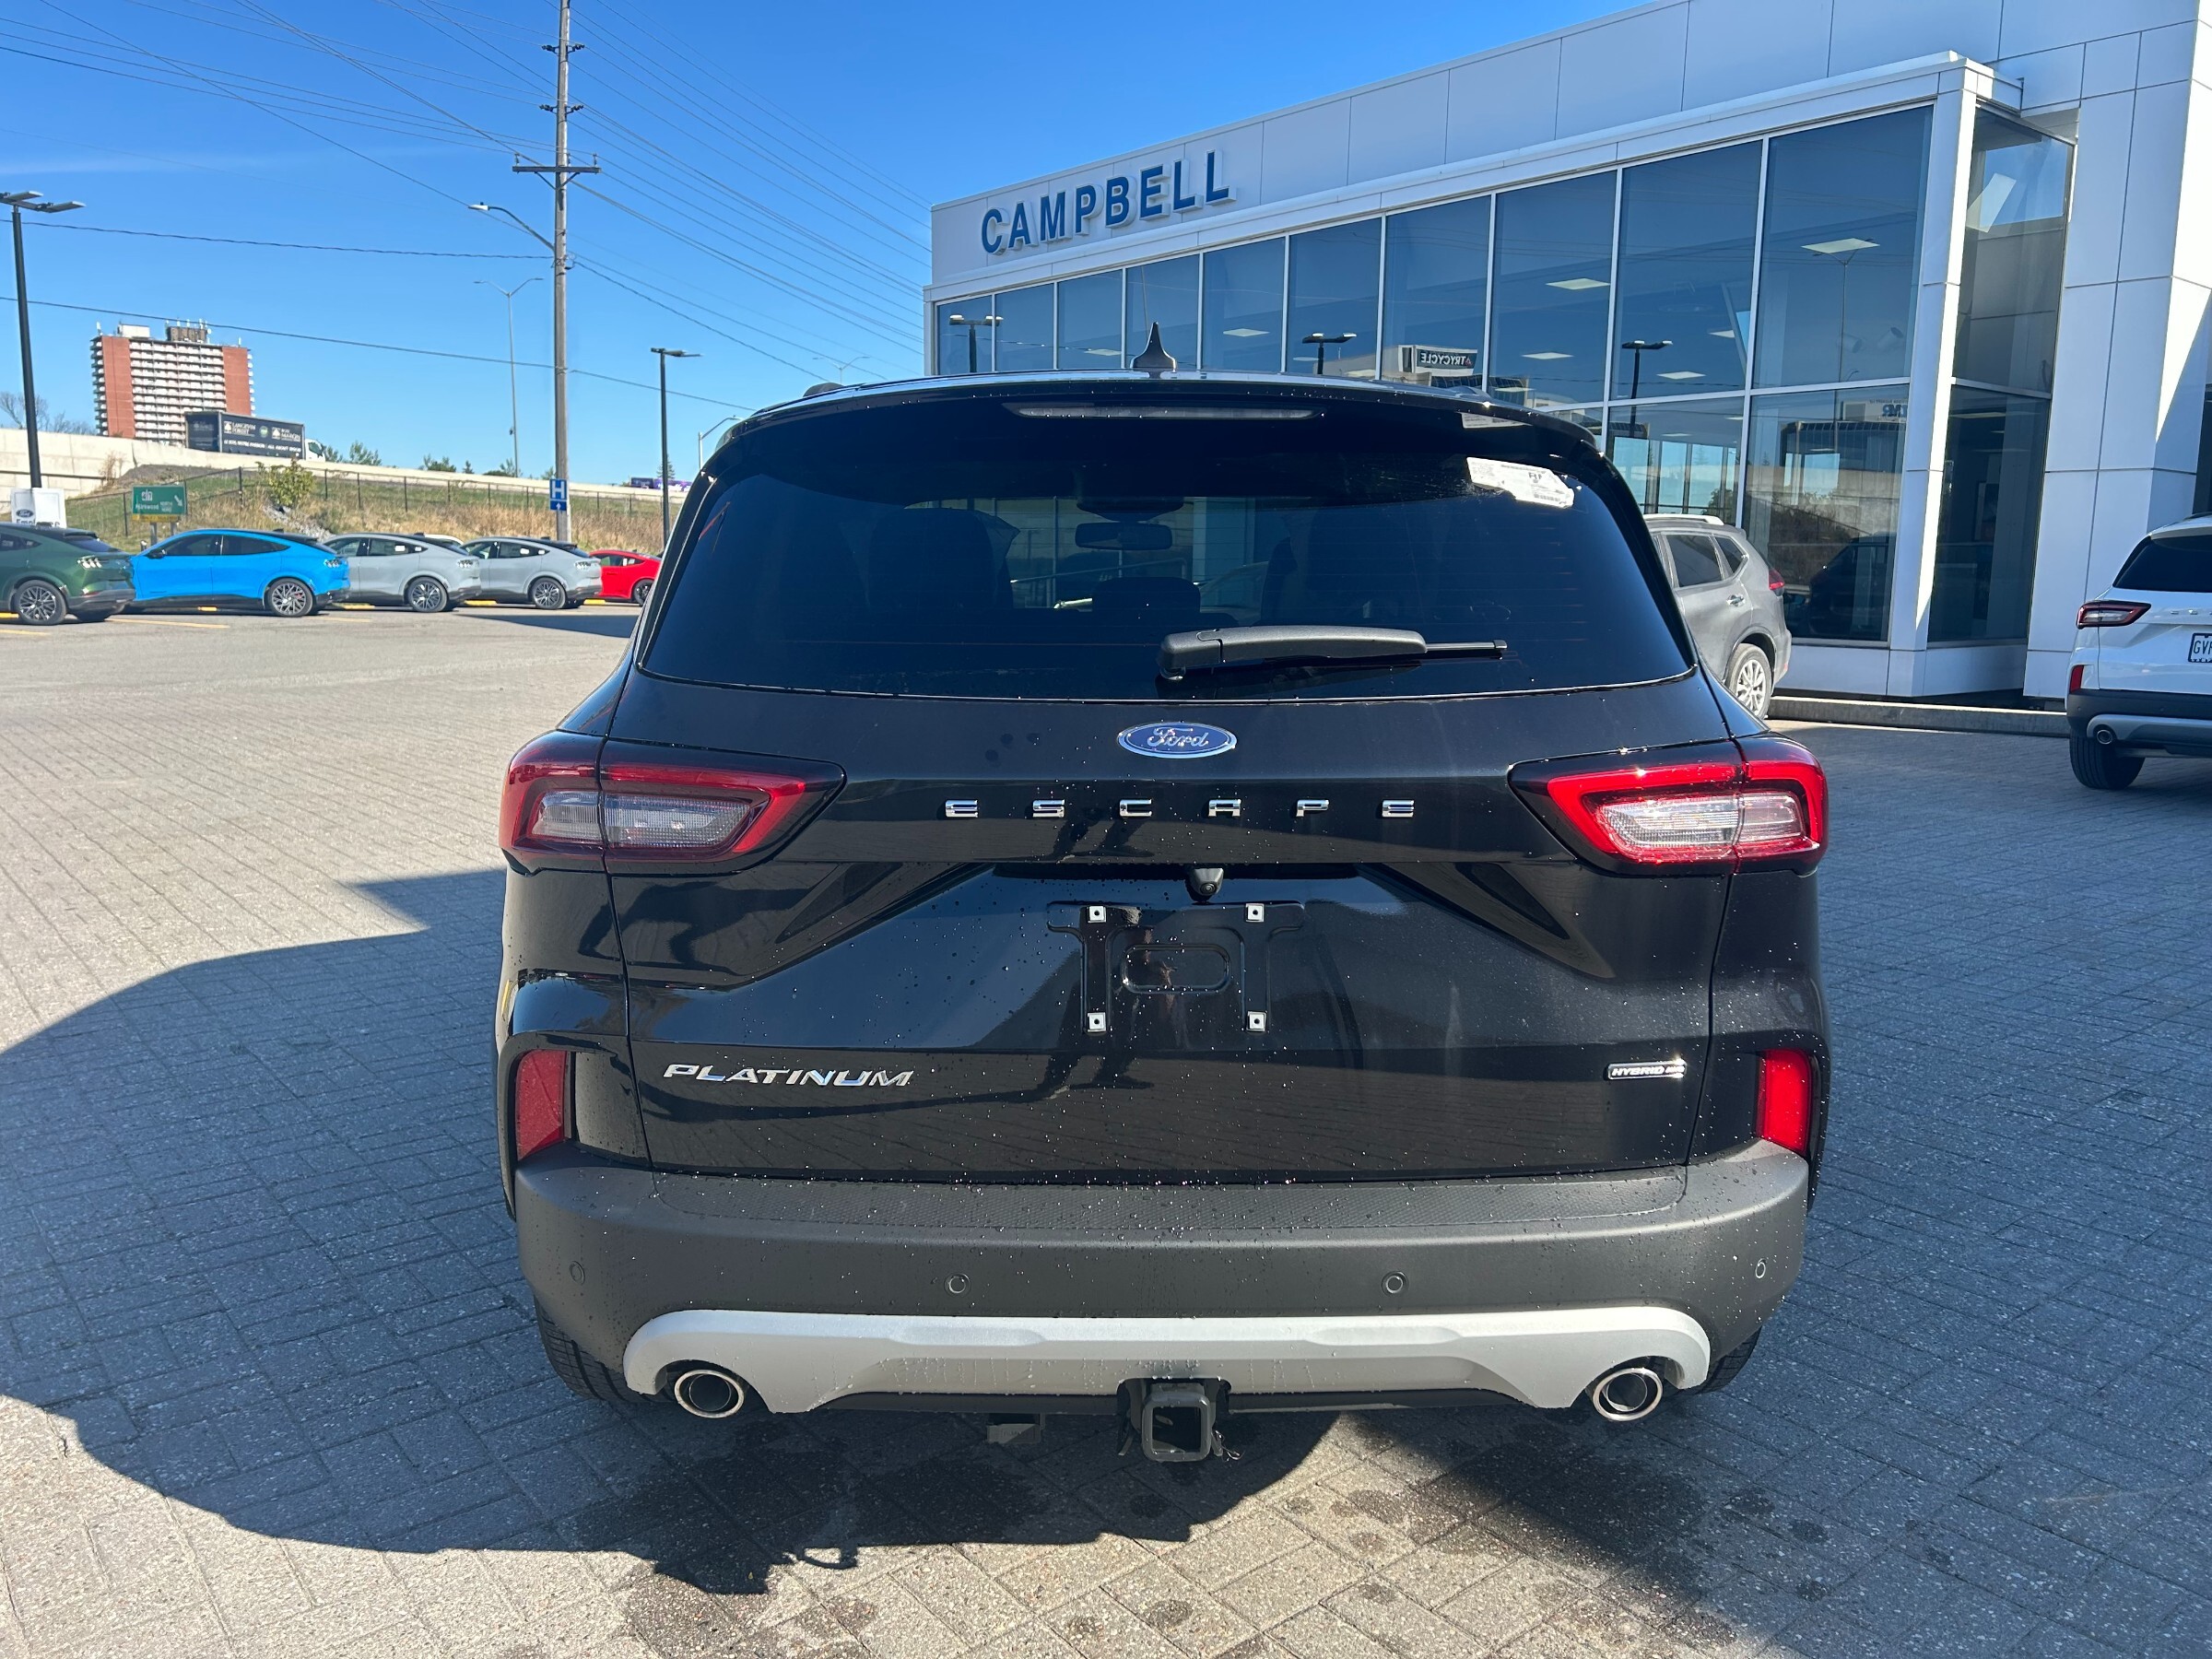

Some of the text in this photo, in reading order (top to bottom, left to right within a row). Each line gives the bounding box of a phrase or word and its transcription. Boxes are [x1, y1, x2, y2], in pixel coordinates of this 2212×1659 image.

[982, 150, 1235, 254] CAMPBELL
[552, 480, 564, 499] H
[1147, 727, 1209, 747] Ford
[945, 799, 1415, 818] ESCAPE
[663, 1064, 914, 1087] PLATINUM
[1611, 1065, 1665, 1077] HYBRID
